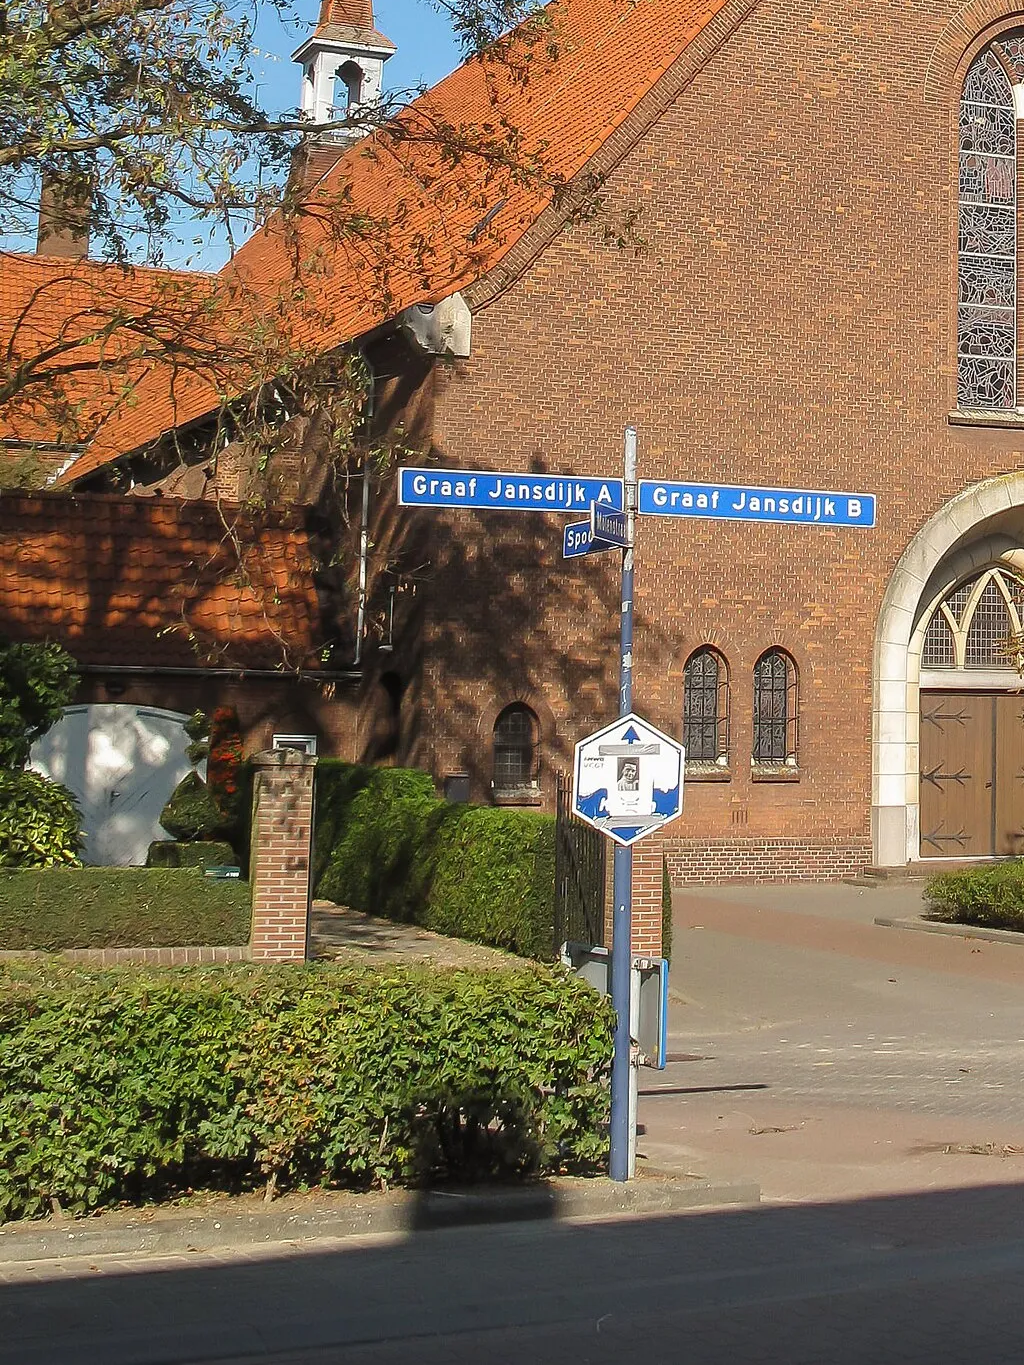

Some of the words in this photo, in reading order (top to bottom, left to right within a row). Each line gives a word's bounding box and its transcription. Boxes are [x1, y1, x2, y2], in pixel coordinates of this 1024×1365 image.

[413, 475, 477, 497] Graaf
[489, 479, 586, 507] Jansdijk
[597, 484, 613, 503] A
[653, 487, 720, 509] Graaf
[732, 492, 836, 521] Jansdijk
[847, 499, 862, 518] B
[567, 530, 594, 550] Spoo
